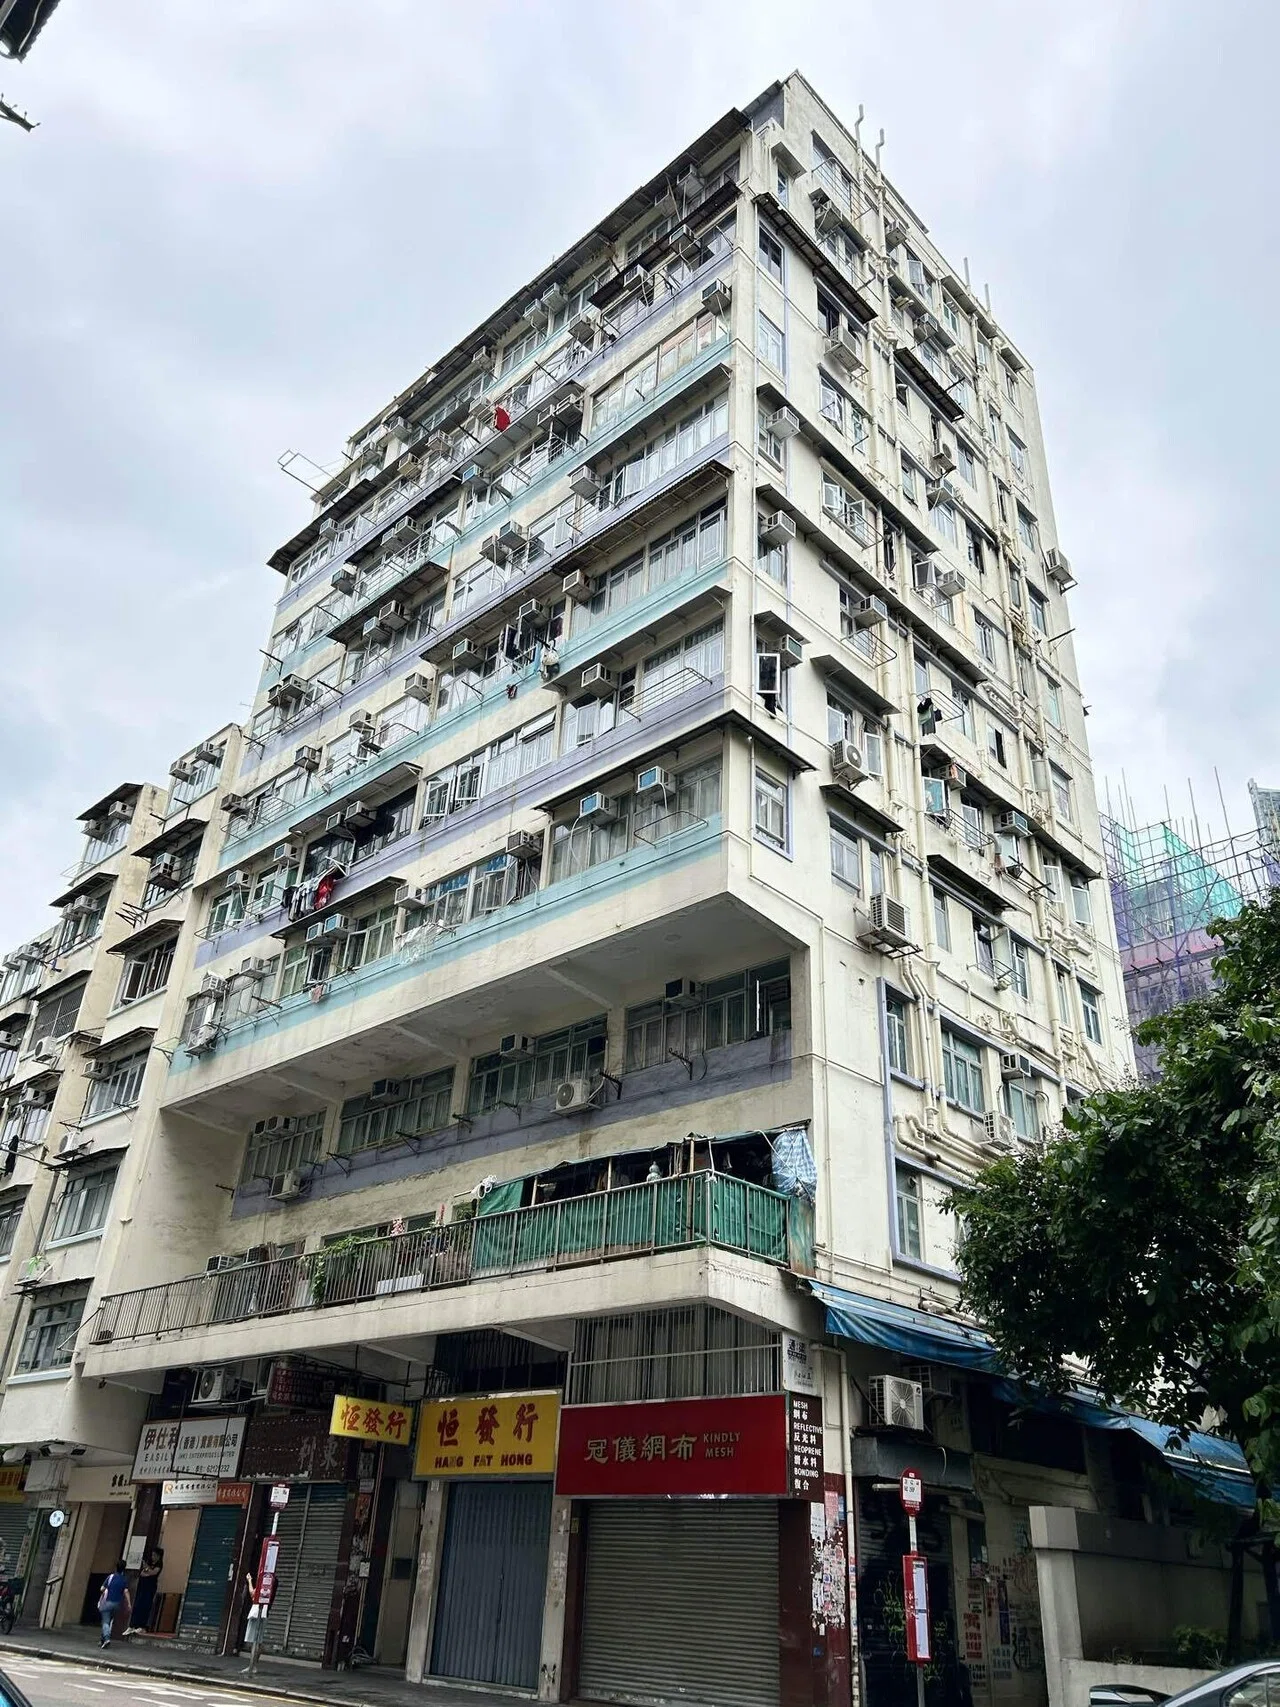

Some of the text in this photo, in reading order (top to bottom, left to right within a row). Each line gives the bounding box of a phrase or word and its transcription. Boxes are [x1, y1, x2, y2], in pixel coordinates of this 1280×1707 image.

[793, 1400, 808, 1410] MESH
[793, 1421, 823, 1435] REFLECTIVE
[703, 1432, 741, 1443] KINDLY
[793, 1431, 816, 1445] 反光料
[584, 1433, 698, 1464] 冠儀網布
[705, 1447, 734, 1459] MESH
[794, 1444, 822, 1456] NEOPRENE
[500, 1453, 533, 1467] HONG
[794, 1467, 819, 1479] BONDING
